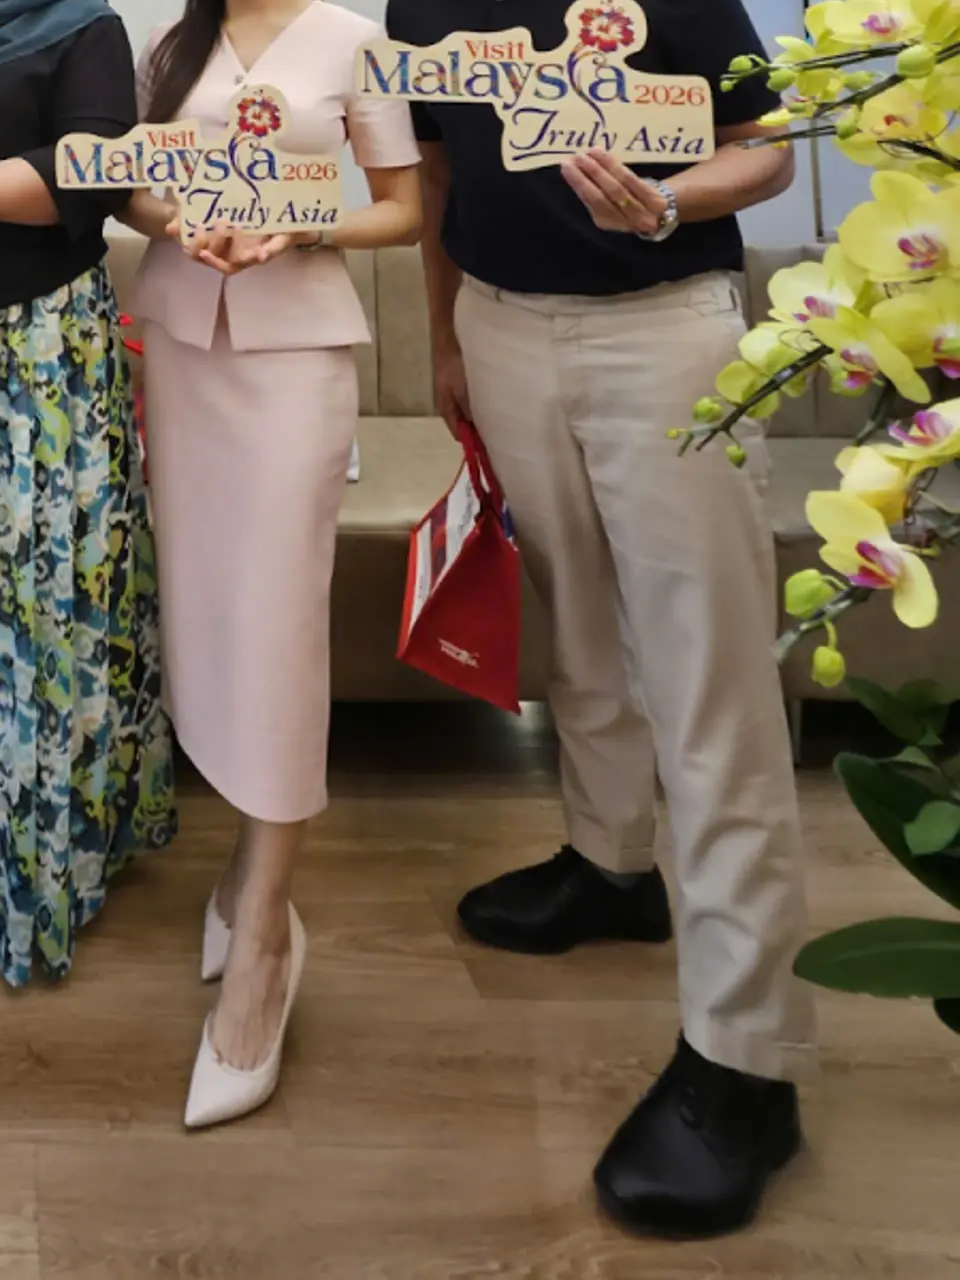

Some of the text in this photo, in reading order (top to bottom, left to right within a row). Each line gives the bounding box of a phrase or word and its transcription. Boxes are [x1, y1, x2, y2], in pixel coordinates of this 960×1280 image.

[465, 38, 525, 61] Visit
[361, 46, 706, 118] Malaysia 2026
[146, 129, 196, 149] Visit
[509, 107, 705, 156] Truly Asia
[63, 135, 338, 195] Malaysia 2026
[185, 187, 339, 230] Truly Asia
